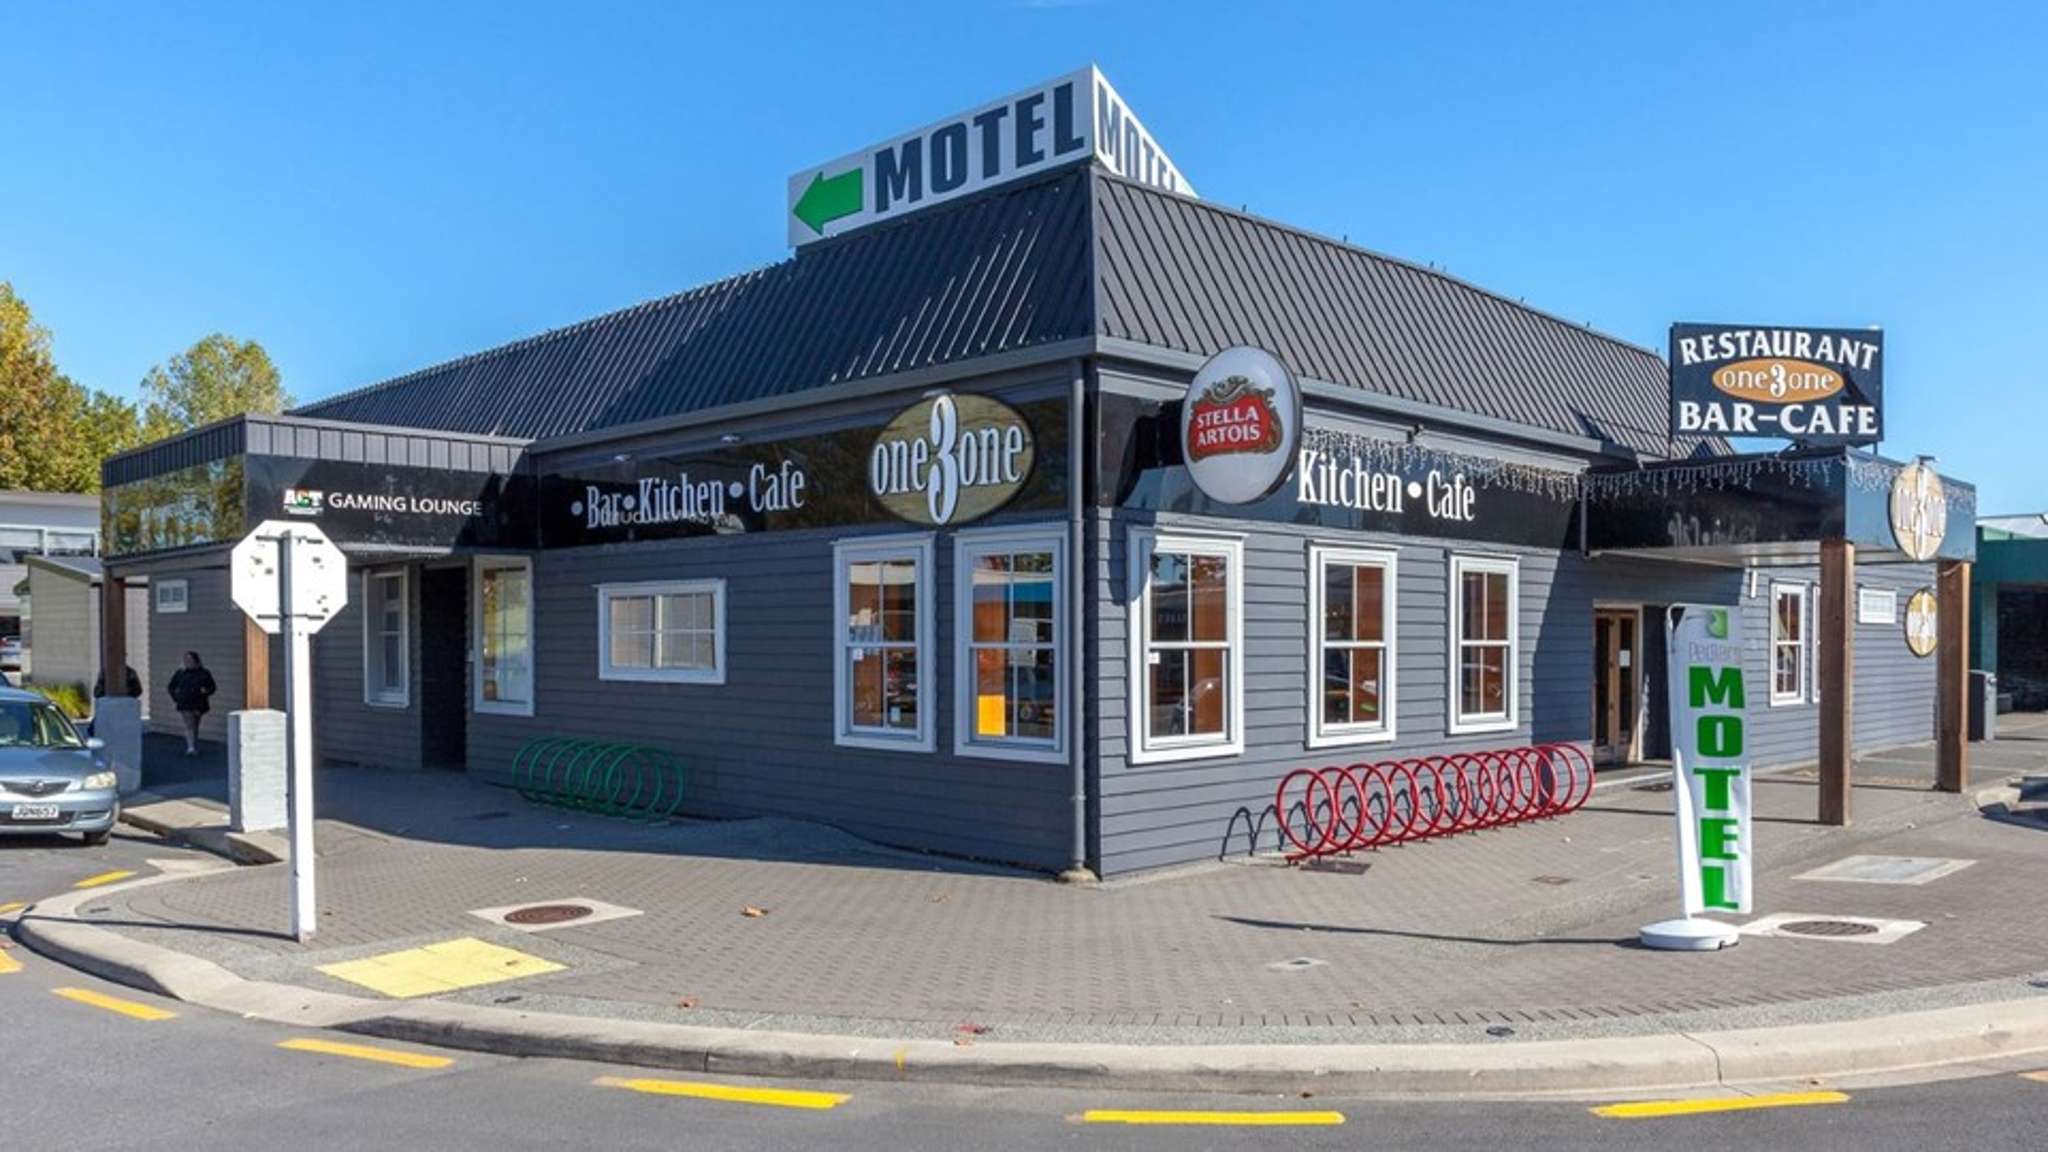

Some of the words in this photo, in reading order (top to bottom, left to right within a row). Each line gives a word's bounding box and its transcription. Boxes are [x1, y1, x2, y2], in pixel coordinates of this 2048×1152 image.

[876, 82, 1085, 213] MOTEL
[1679, 330, 1878, 370] RESTAURANT
[1196, 405, 1260, 429] STELLA
[1196, 423, 1260, 447] ARTOIS
[328, 492, 407, 512] GAMING
[411, 497, 483, 516] LOUNGE
[586, 485, 622, 529] Bar
[638, 472, 724, 524] Kitchen
[750, 460, 805, 513] Cafe
[1296, 450, 1403, 514] Kitchen
[1426, 468, 1475, 521] Cafe
[1687, 665, 1746, 910] MOTEL
